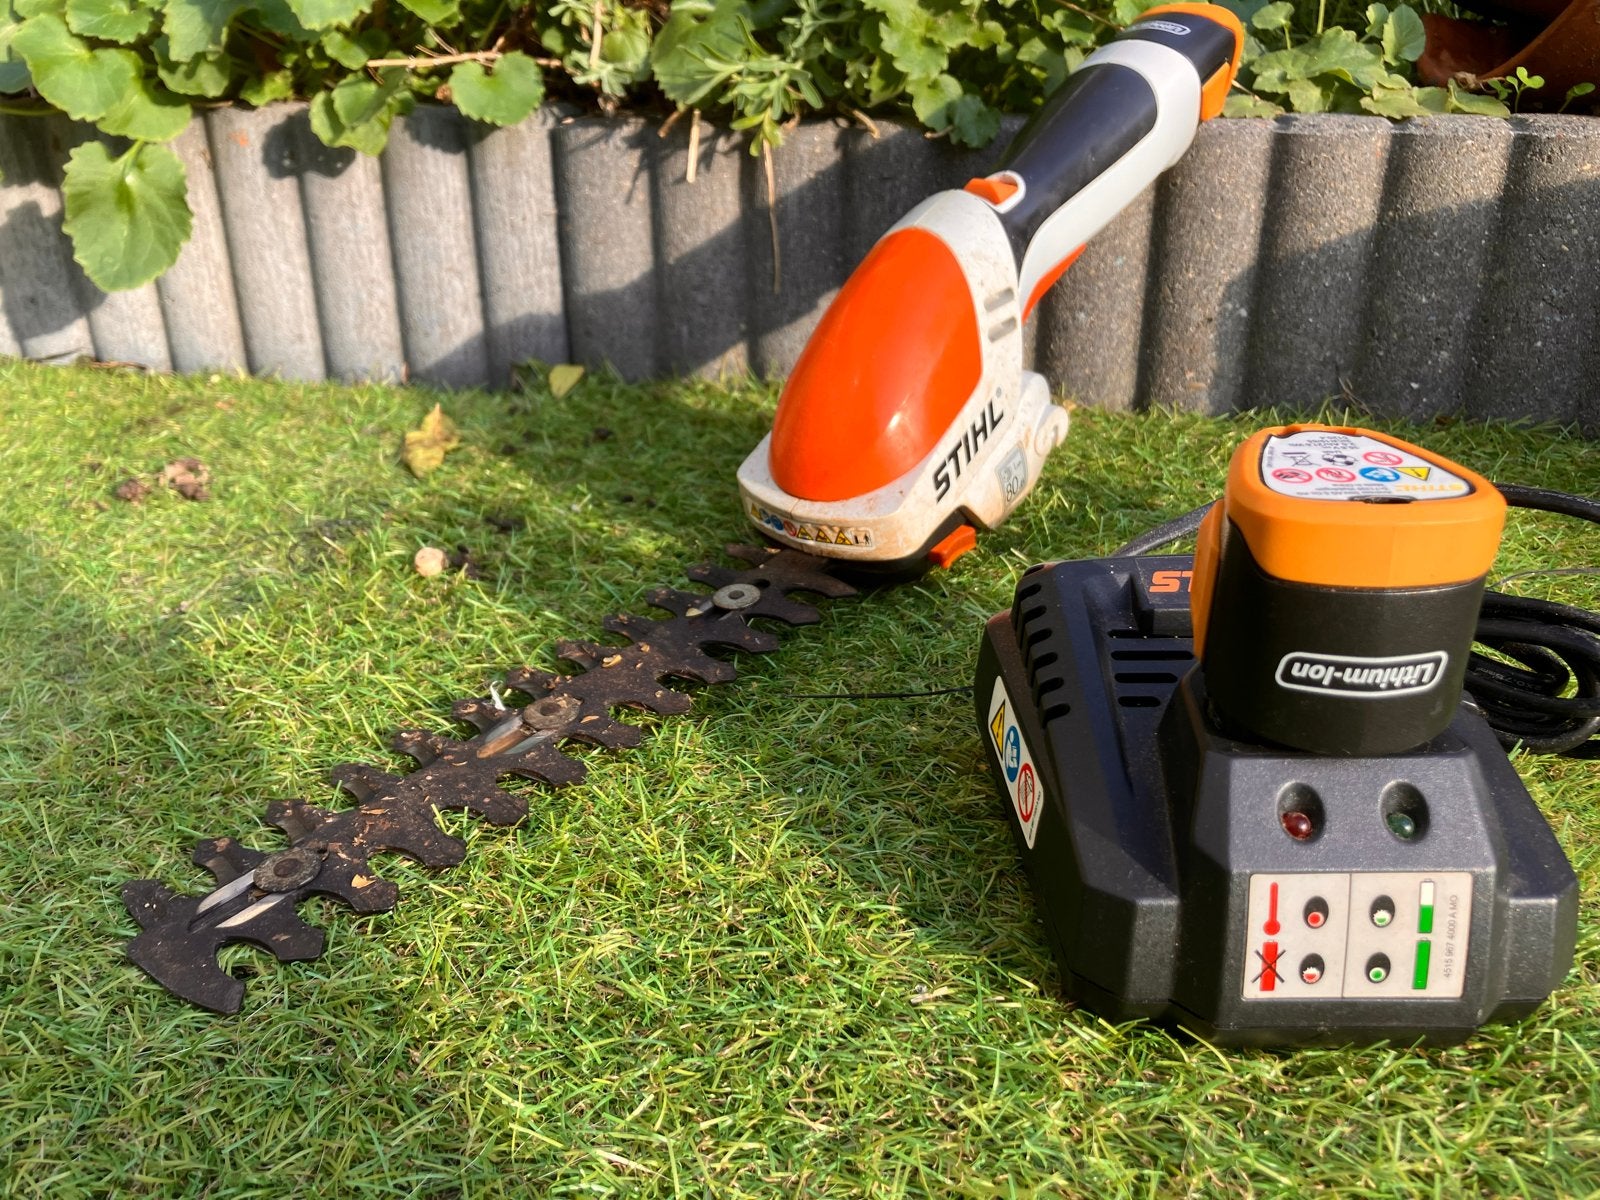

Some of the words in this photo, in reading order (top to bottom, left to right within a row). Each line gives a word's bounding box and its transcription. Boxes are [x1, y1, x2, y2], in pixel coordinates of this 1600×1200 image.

[932, 399, 1004, 504] STIHL
[1290, 662, 1436, 689] Lithium-Ion
[1447, 919, 1456, 940] 4000
